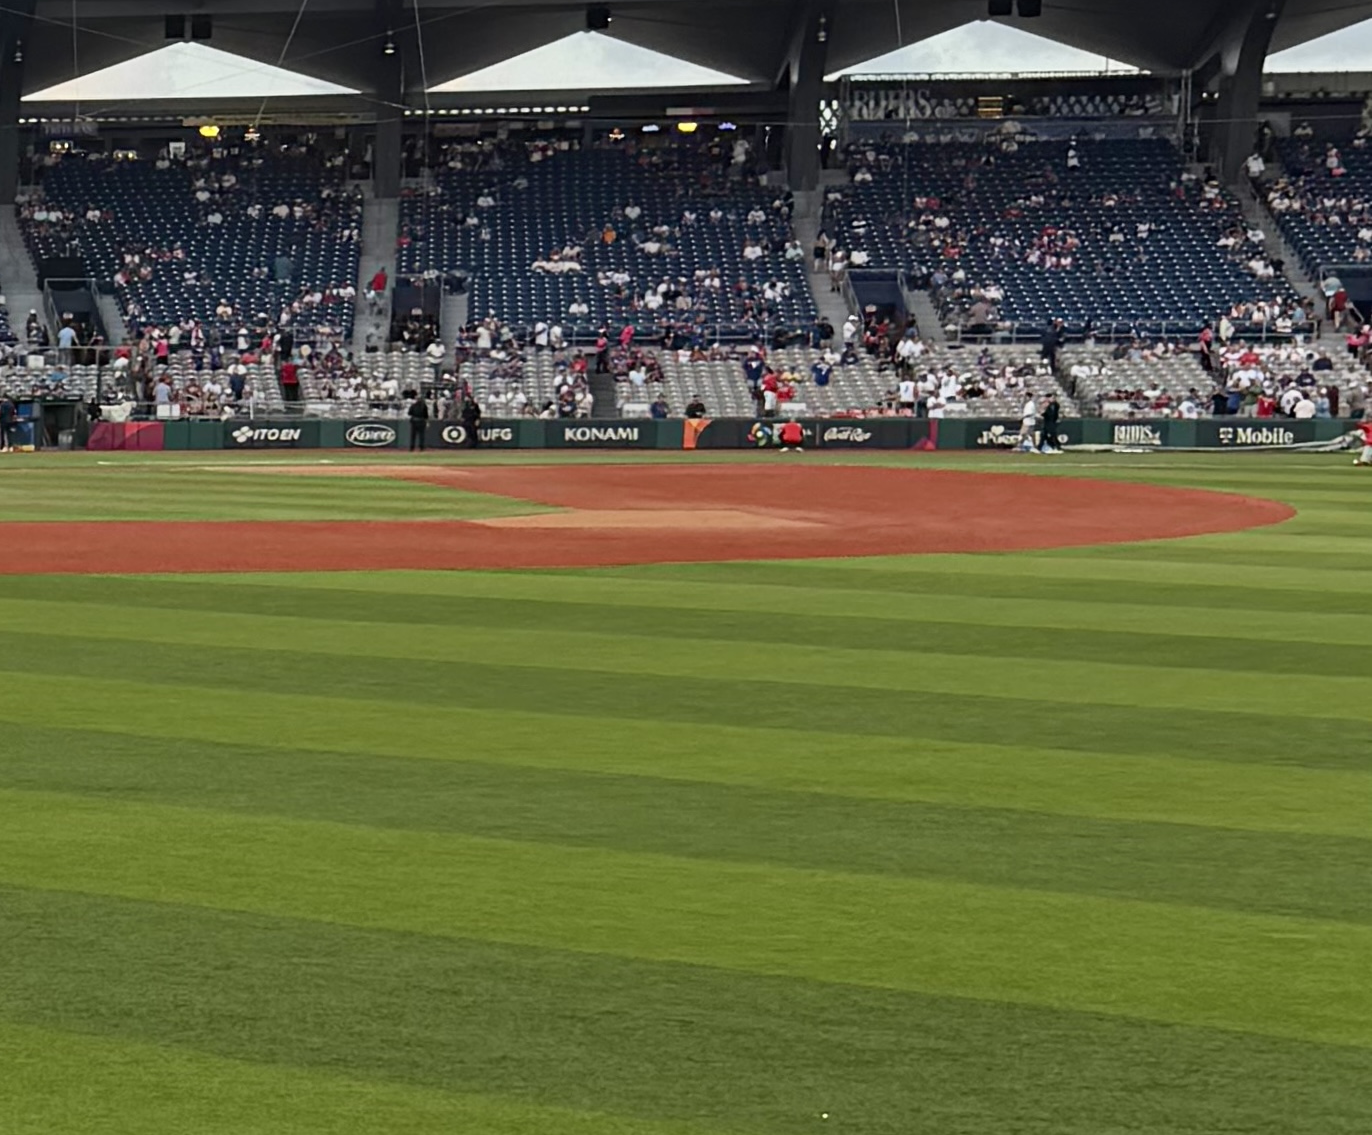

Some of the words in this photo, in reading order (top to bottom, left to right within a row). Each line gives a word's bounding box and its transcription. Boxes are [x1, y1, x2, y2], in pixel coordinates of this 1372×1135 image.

[253, 428, 279, 441] ITO
[280, 428, 302, 441] EN
[477, 428, 512, 441] UFG
[564, 427, 640, 441] KONAMI
[1236, 427, 1294, 444] Mobile
